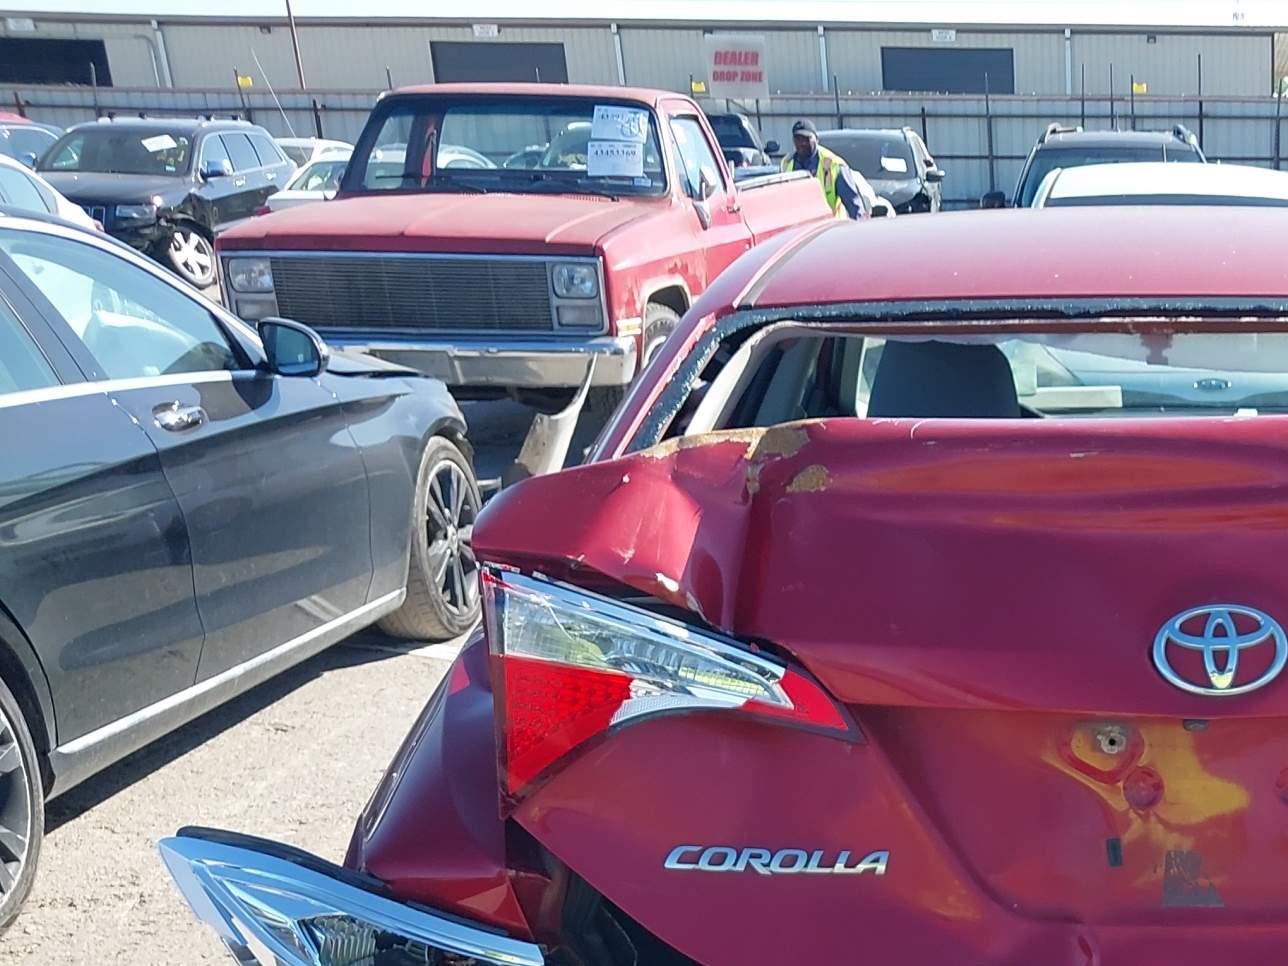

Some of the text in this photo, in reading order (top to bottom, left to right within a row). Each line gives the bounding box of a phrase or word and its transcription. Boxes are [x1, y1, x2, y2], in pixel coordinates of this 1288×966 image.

[714, 51, 759, 66] DEALER
[712, 71, 763, 82] DROP ZONE
[664, 845, 890, 875] COROLLA
